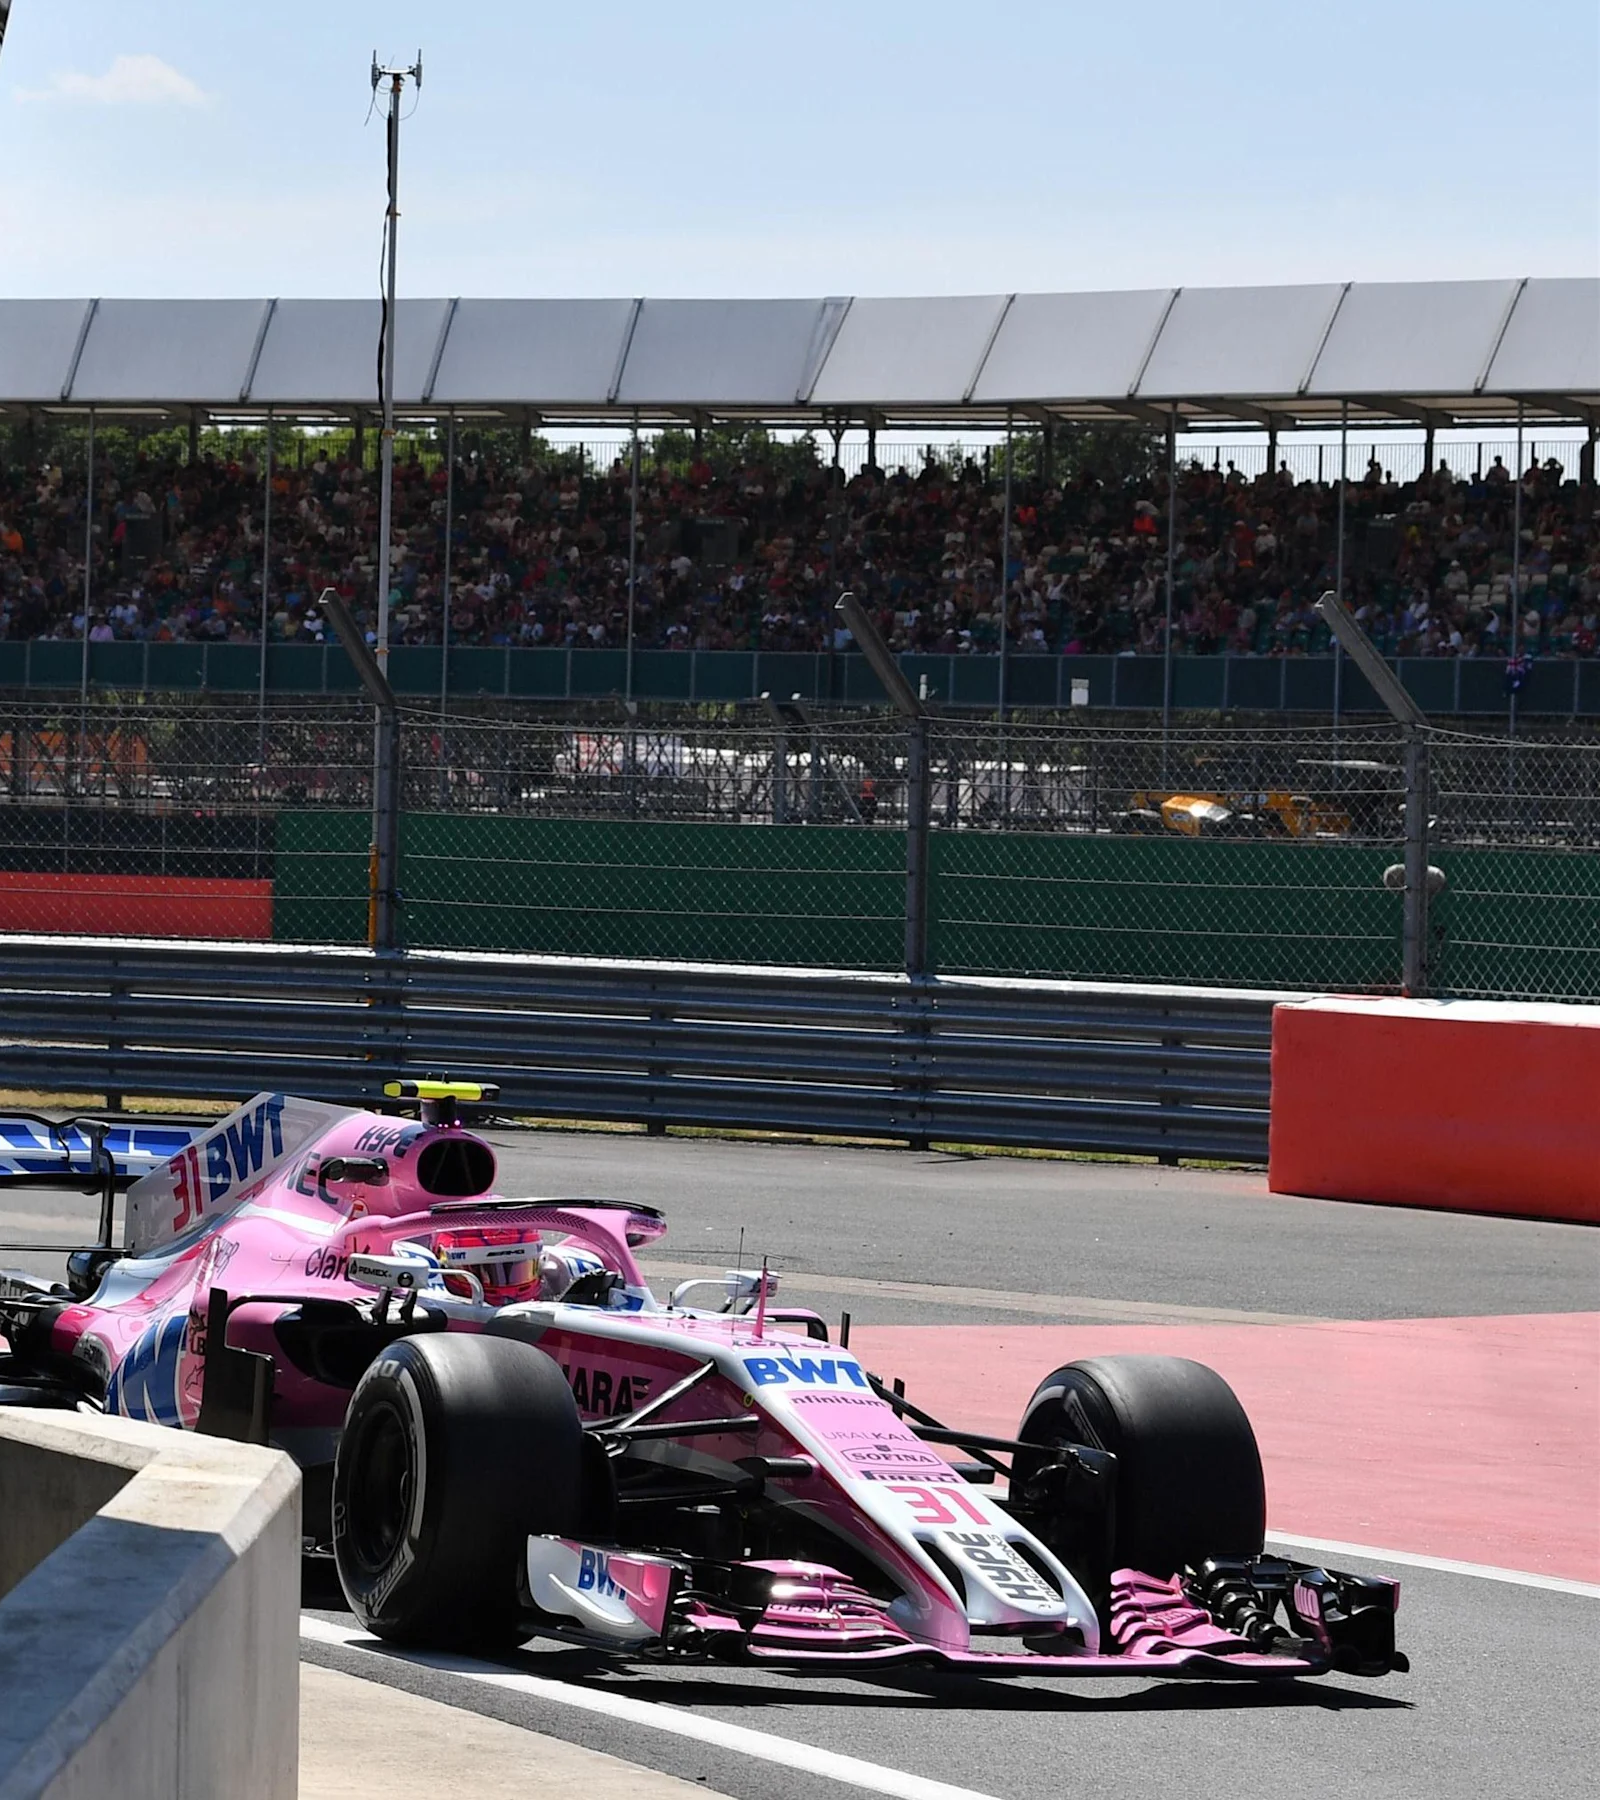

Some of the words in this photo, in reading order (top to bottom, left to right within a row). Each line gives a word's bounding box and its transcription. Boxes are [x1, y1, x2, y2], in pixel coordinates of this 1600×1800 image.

[206, 1094, 285, 1201] BWT
[169, 1146, 203, 1232] 31
[305, 1246, 352, 1282] Clar
[743, 1357, 869, 1388] BWT
[852, 1453, 935, 1464] SOFINA
[860, 1470, 965, 1483] PIRELLI
[885, 1485, 992, 1526] 31
[943, 1530, 1053, 1601] HYPE
